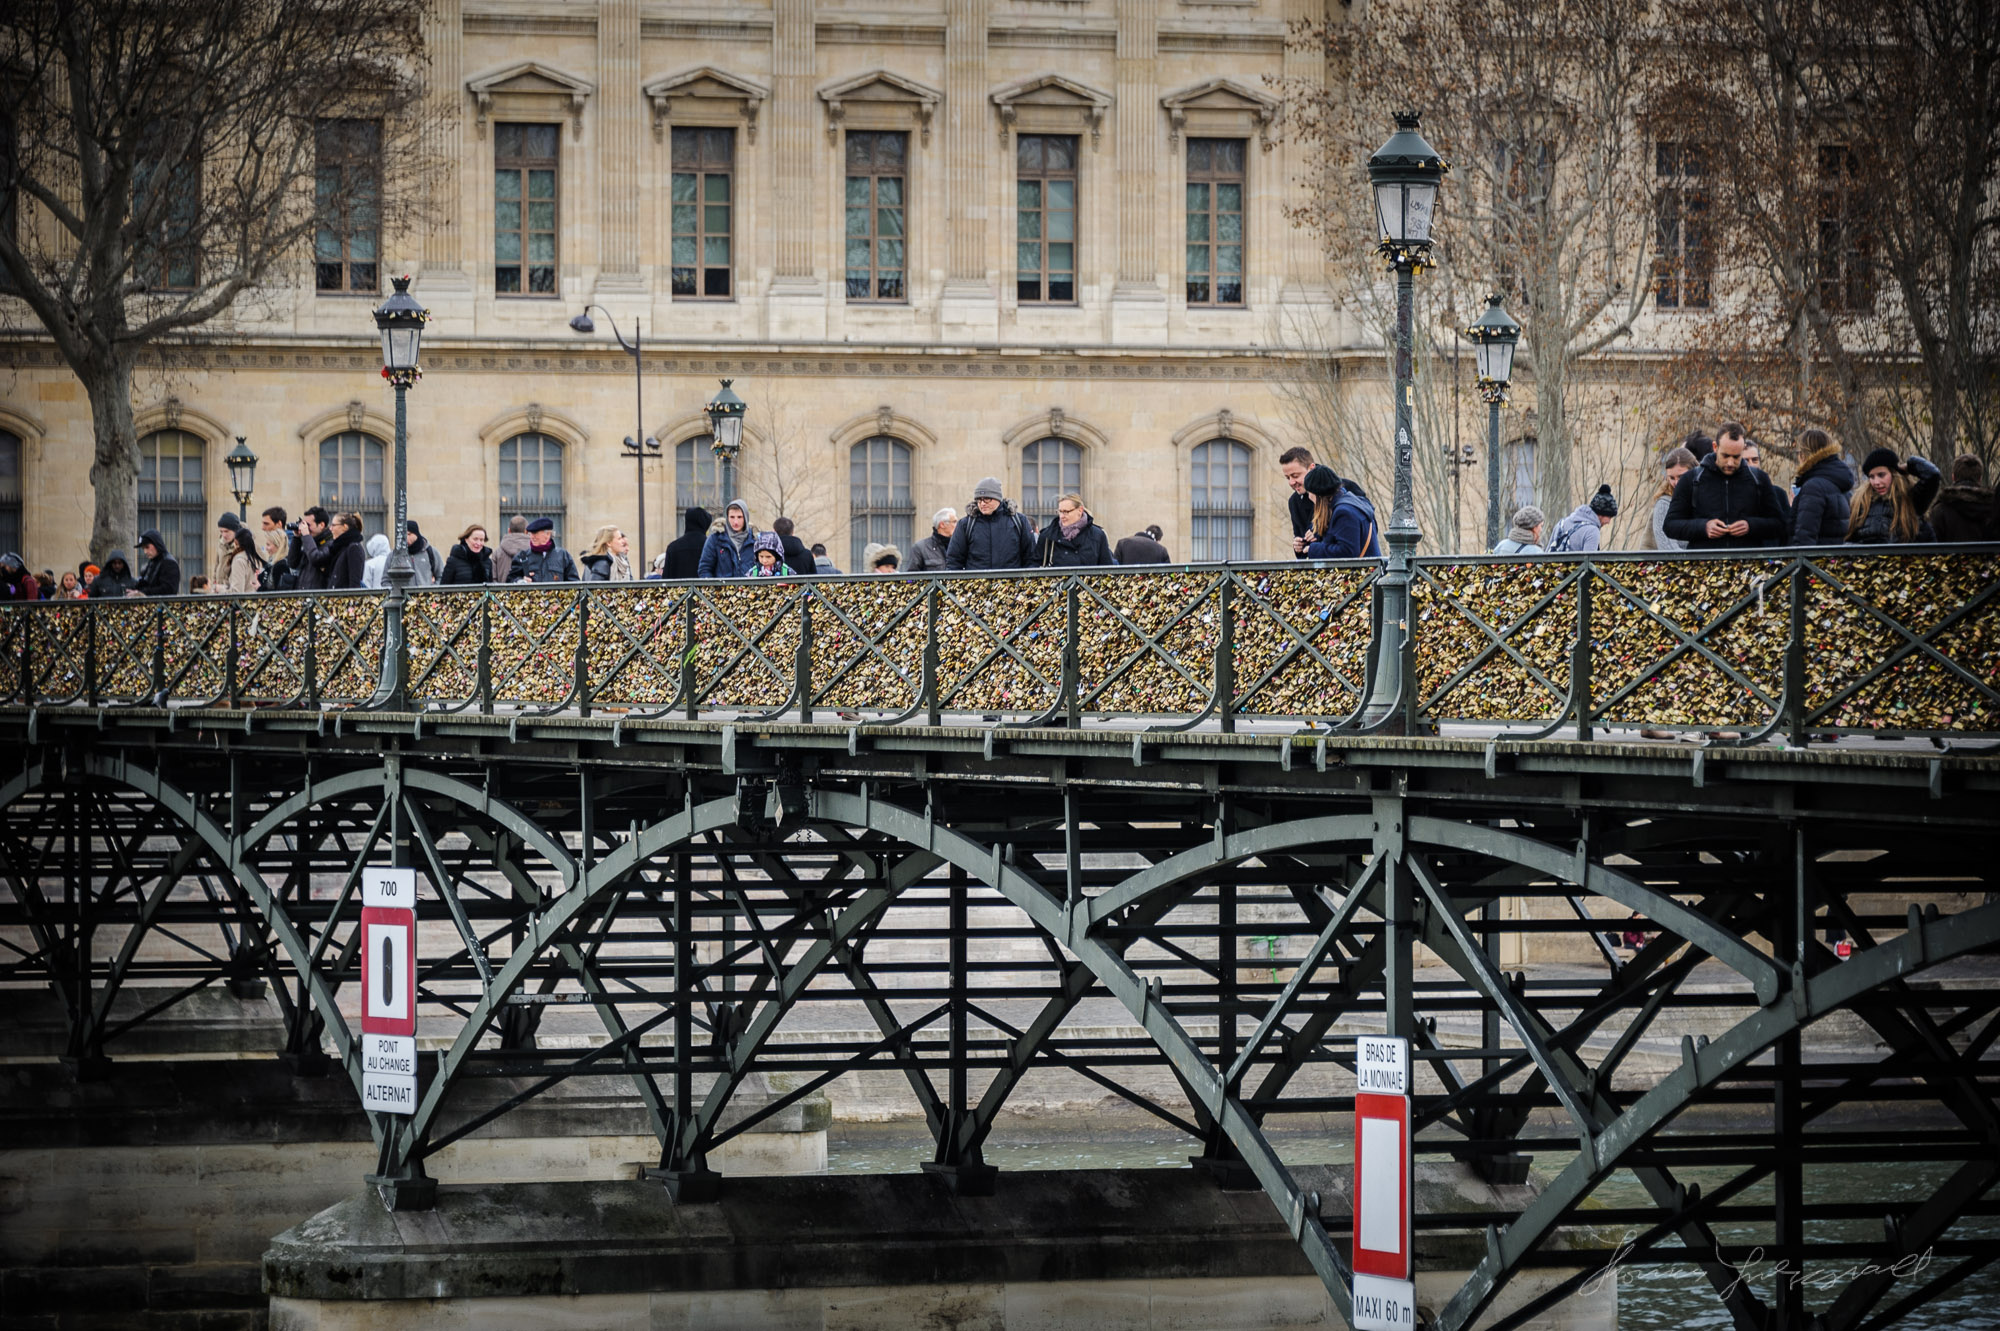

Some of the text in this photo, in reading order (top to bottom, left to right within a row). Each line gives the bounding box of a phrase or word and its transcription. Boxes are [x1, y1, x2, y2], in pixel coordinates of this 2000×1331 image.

[380, 880, 397, 896] 700
[378, 1039, 399, 1054] PONT
[1366, 1043, 1396, 1064] BRAS DE
[367, 1056, 410, 1072] AU CHANGE
[1359, 1068, 1403, 1090] LA MONNAIE
[366, 1084, 412, 1104] ALTERNAT
[1355, 1295, 1411, 1324] MAXI 60 m
